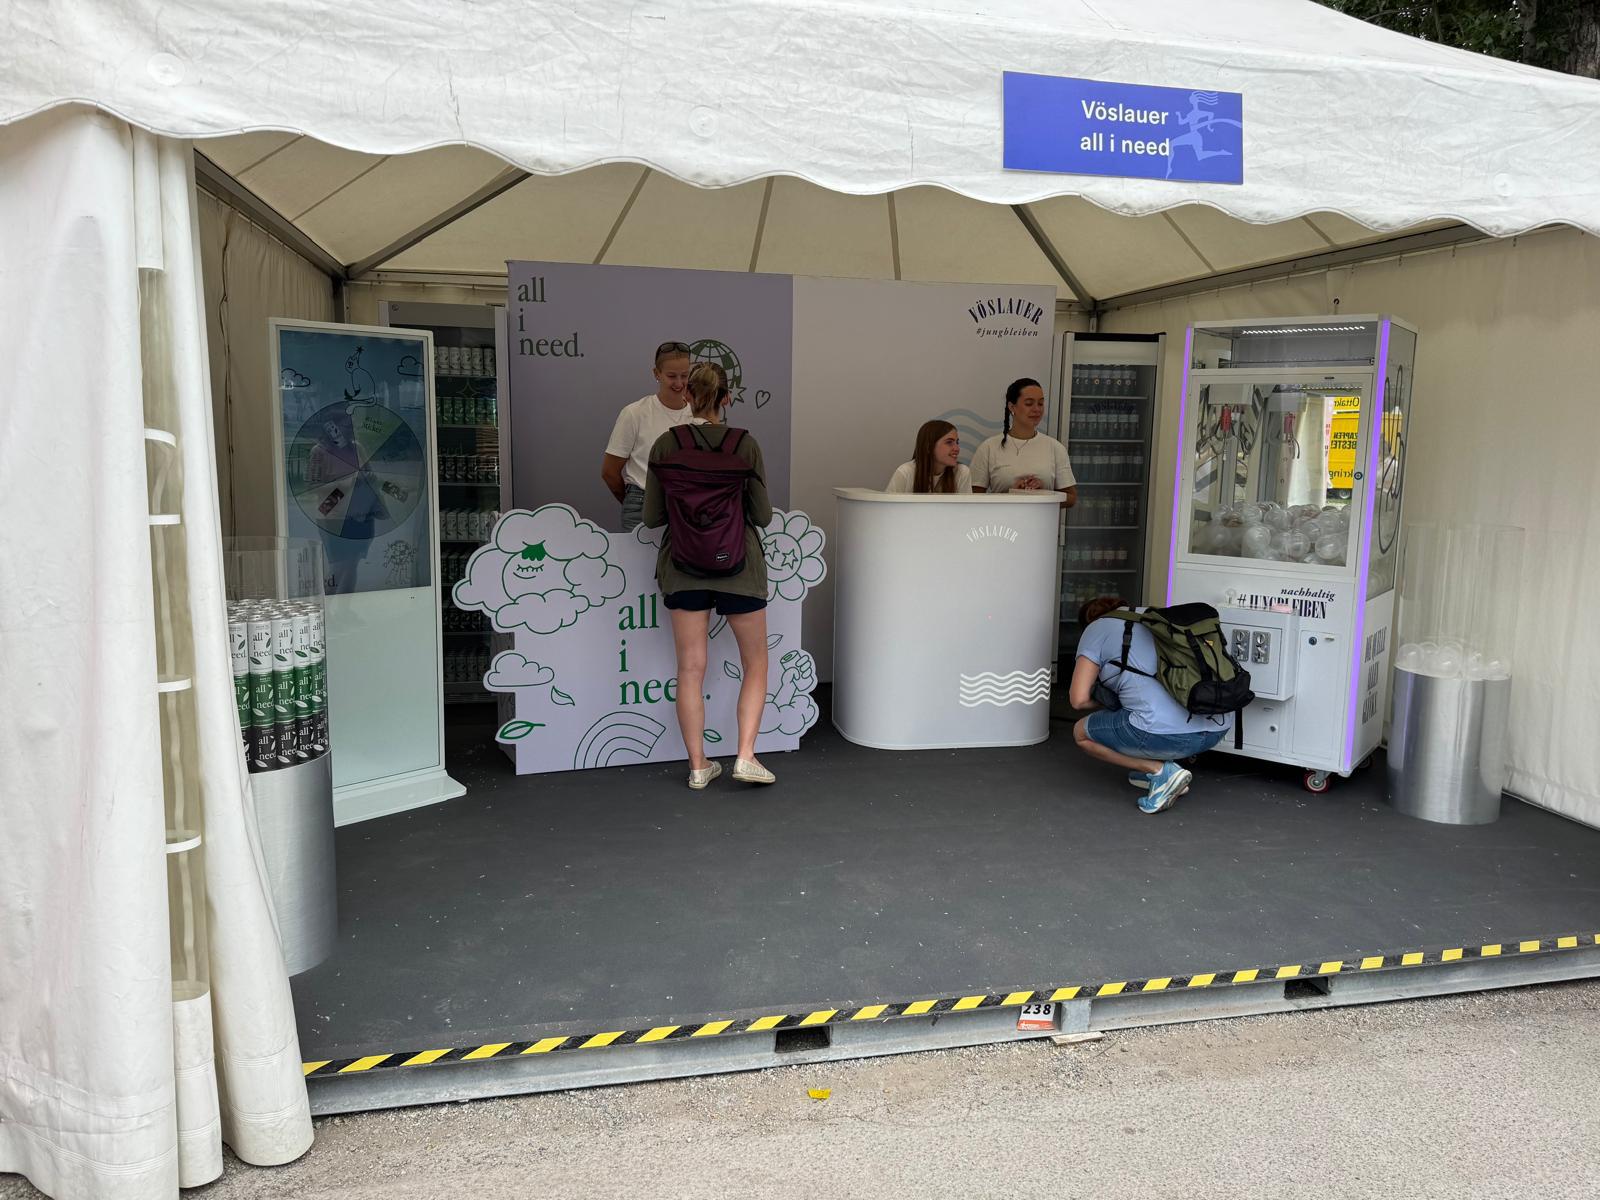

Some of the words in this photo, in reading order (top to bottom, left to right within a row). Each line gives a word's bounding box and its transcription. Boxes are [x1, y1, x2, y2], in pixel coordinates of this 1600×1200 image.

[1081, 100, 1169, 125] Vöslauer
[1080, 132, 1103, 151] all
[1110, 134, 1115, 152] i
[1121, 138, 1170, 156] need
[517, 277, 546, 303] all
[968, 297, 1043, 325] VÖSLAUER
[518, 308, 526, 332] i
[976, 327, 1038, 338] #jungbleiben
[519, 332, 585, 358] need.
[1281, 587, 1336, 602] nachhaltig
[618, 593, 660, 631] all
[252, 632, 264, 642] all
[278, 629, 289, 638] all
[618, 639, 629, 673] i
[255, 684, 266, 693] all
[278, 681, 288, 690] all
[280, 732, 291, 741] all
[299, 727, 309, 736] all
[258, 736, 269, 745] all
[1022, 1004, 1051, 1015] 238
